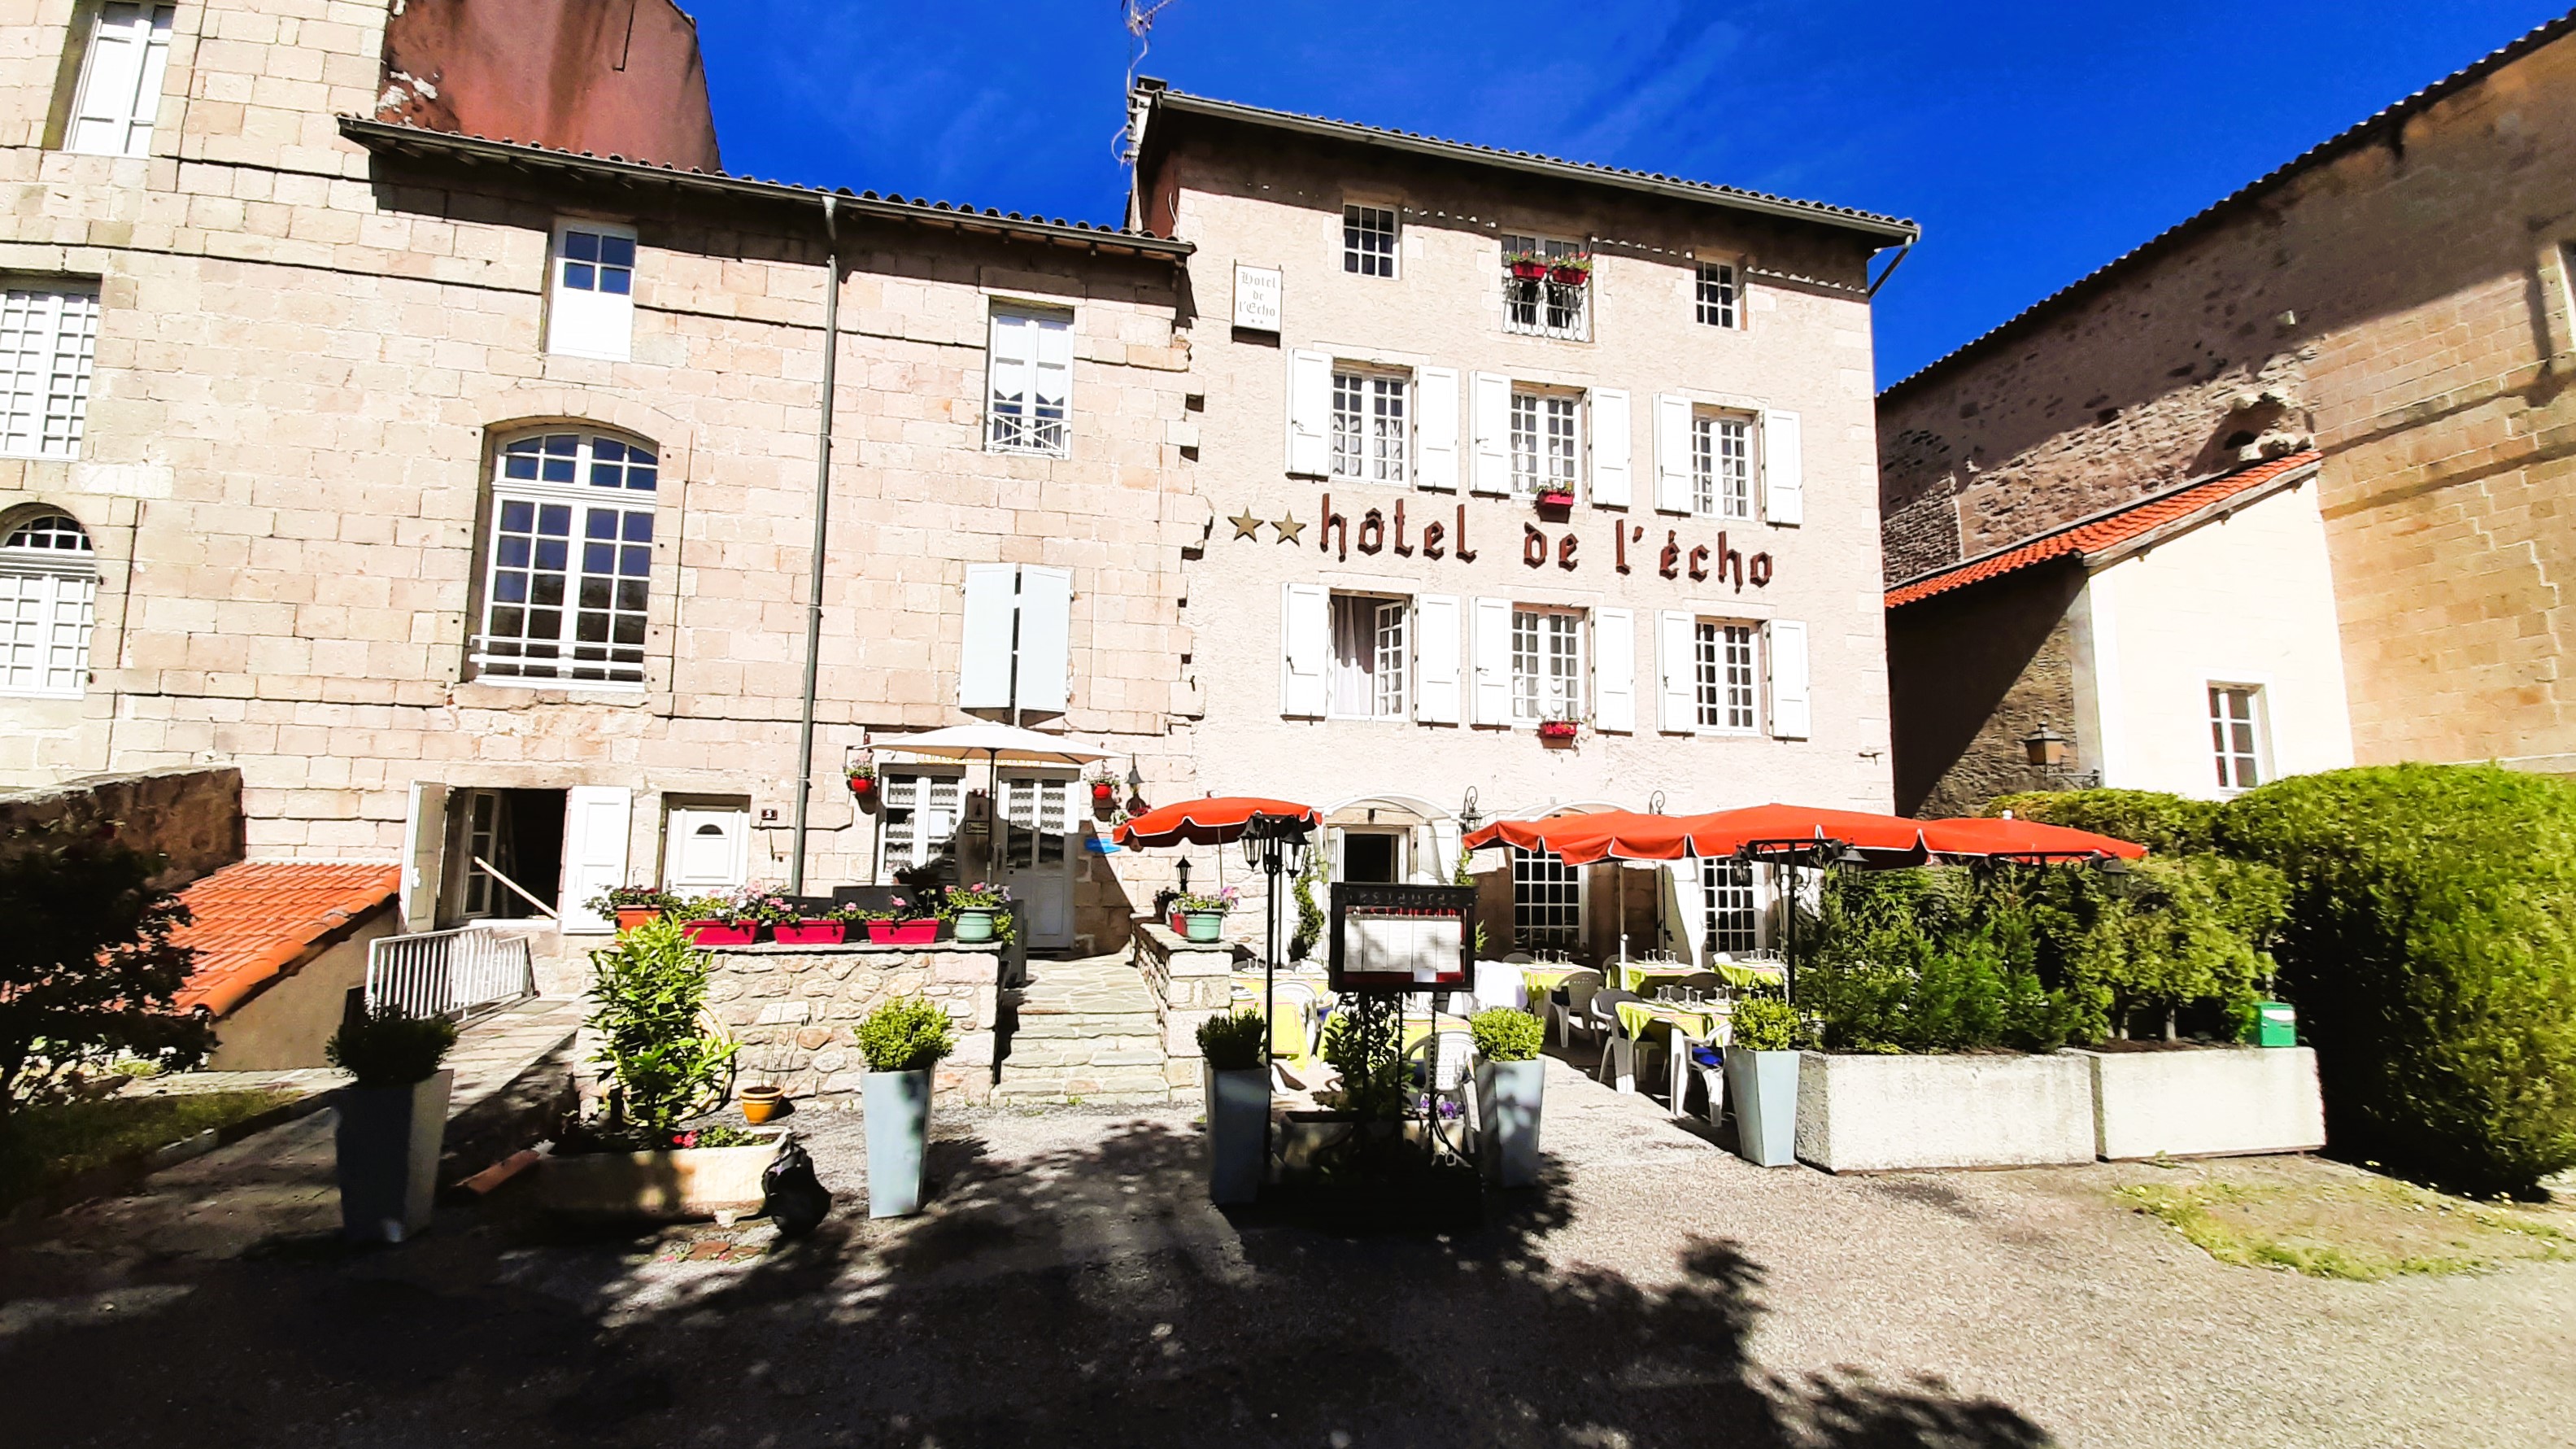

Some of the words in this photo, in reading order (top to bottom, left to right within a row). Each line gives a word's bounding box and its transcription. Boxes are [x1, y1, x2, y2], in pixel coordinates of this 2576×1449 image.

[1253, 290, 1264, 301] de
[1319, 493, 1478, 563] hôtel
[1523, 522, 1580, 572] de
[1615, 518, 1773, 595] l'écho
